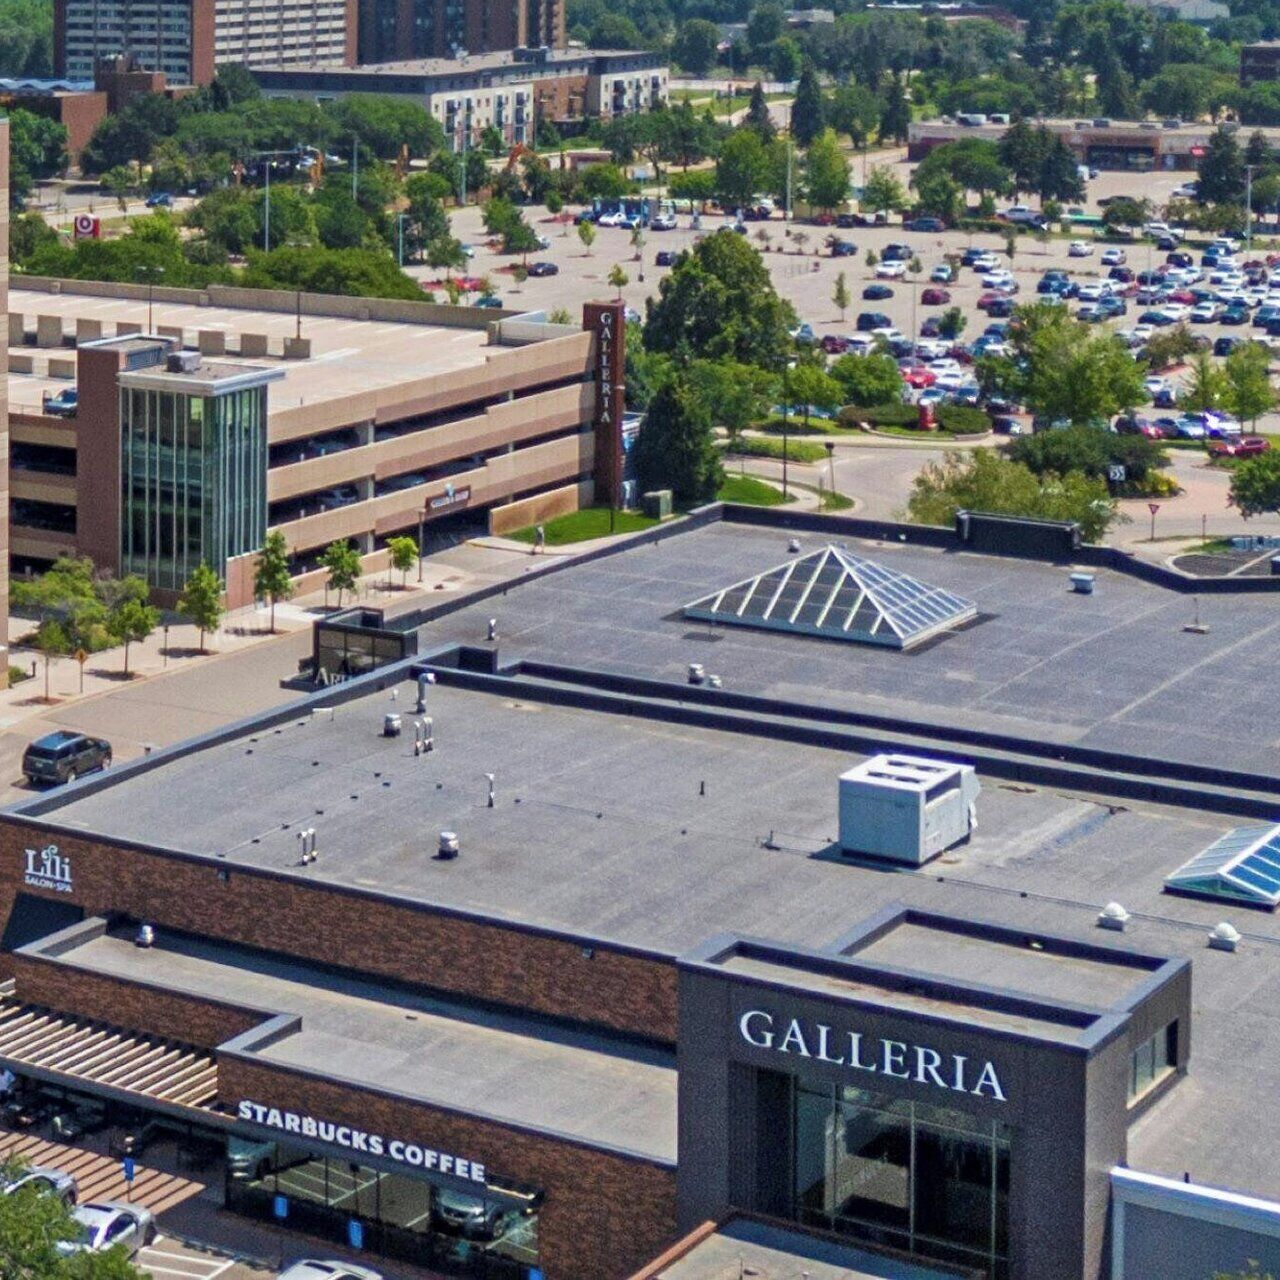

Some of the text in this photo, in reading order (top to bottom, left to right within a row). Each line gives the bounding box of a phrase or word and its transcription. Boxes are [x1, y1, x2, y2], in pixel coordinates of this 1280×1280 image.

[600, 312, 612, 423] GALLERIA
[739, 1010, 1008, 1102] GALLERIA
[238, 1100, 486, 1183] STARBUCKS COFFEE
